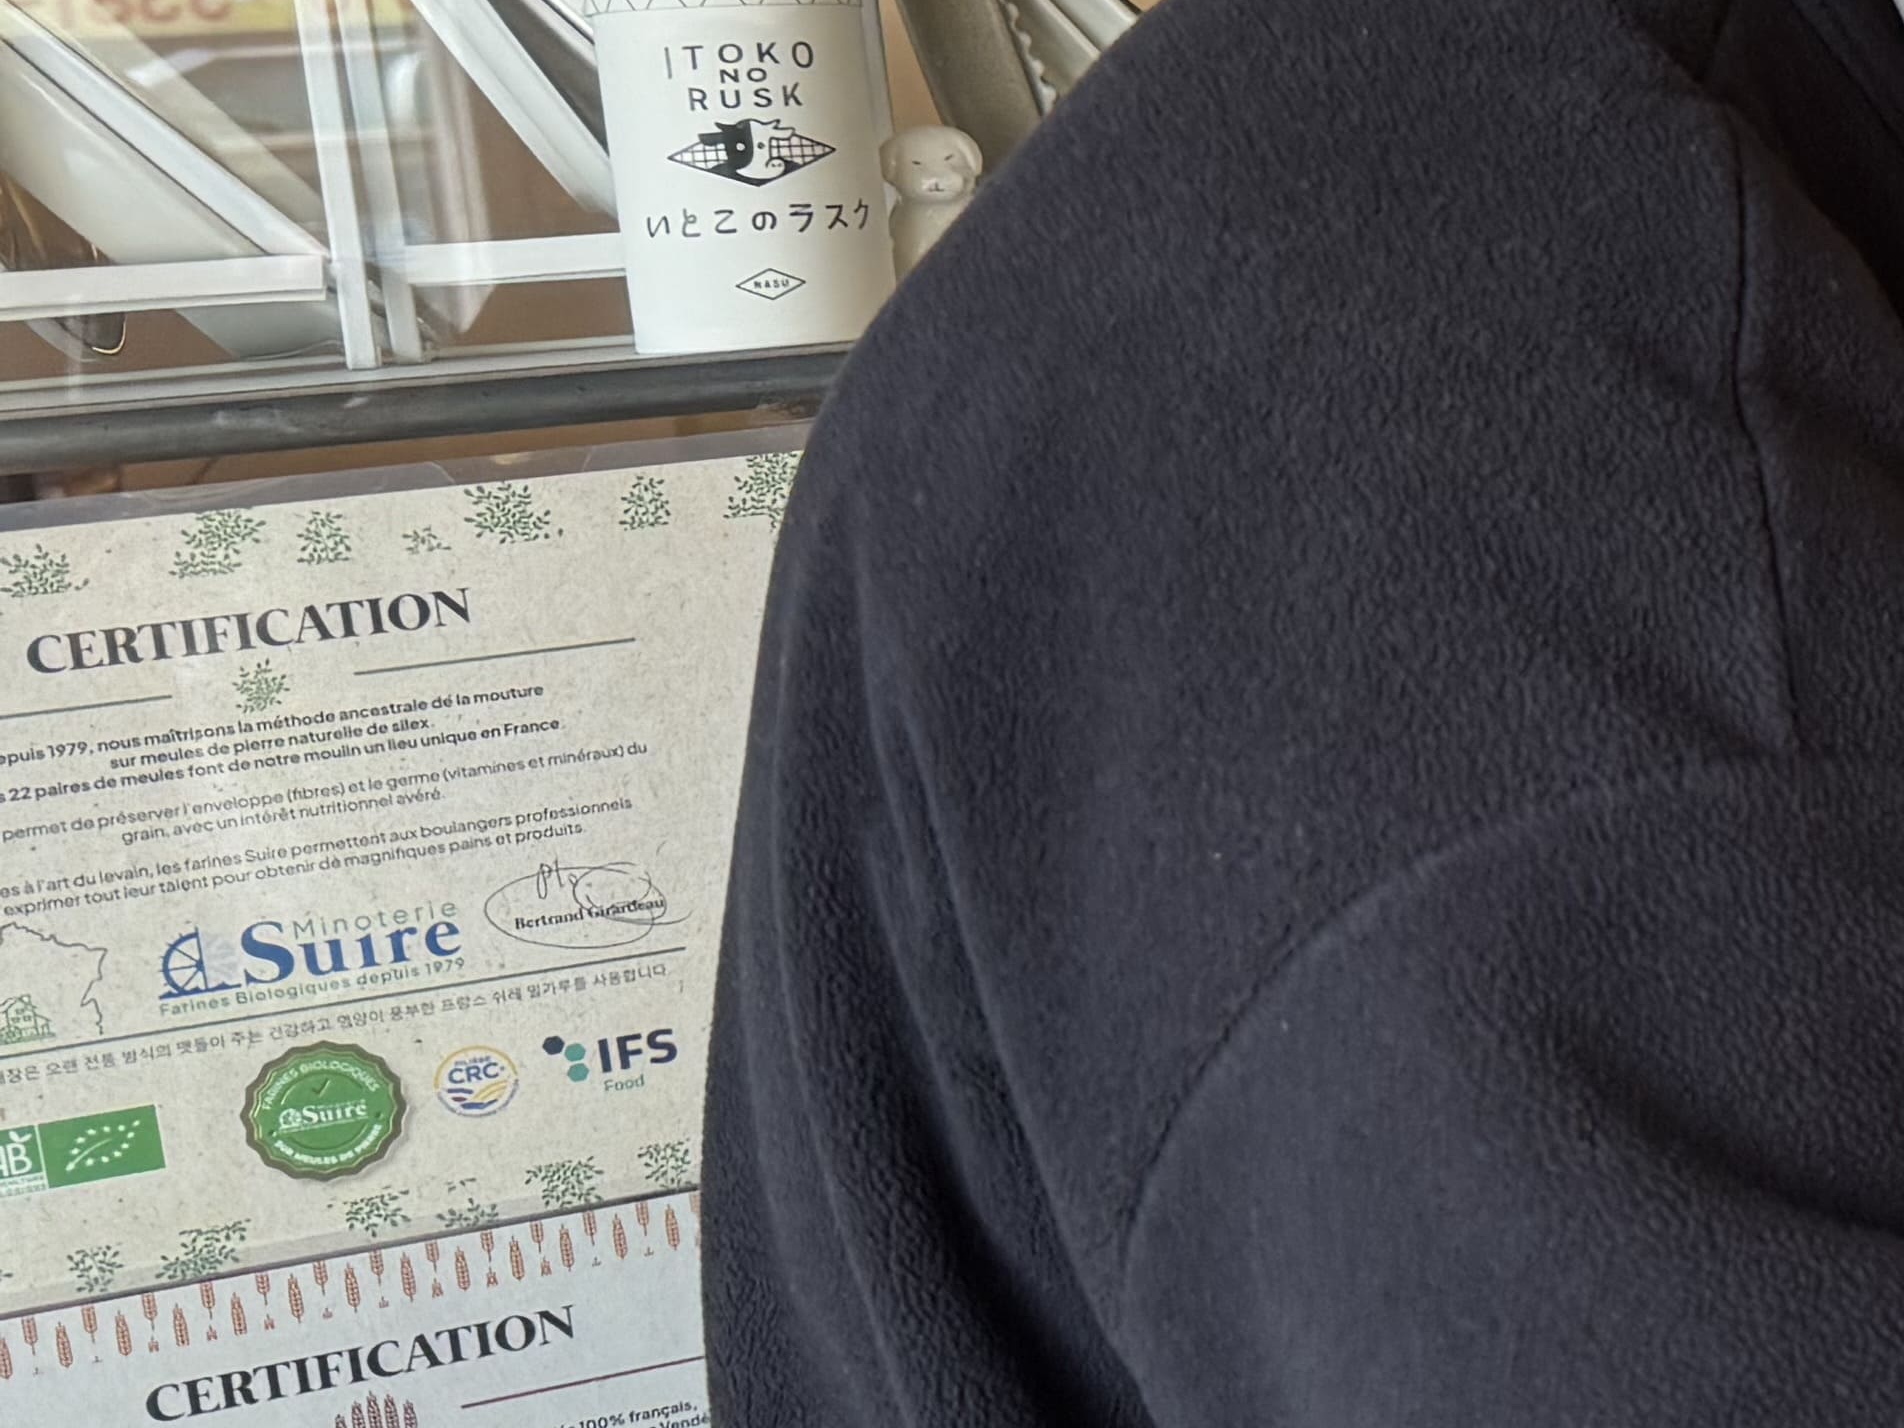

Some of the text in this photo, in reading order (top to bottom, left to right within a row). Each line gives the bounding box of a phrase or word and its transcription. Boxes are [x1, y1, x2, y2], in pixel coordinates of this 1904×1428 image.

[664, 41, 814, 79] ITOKO
[720, 67, 768, 84] NO
[688, 82, 803, 111] RUSK
[646, 198, 870, 238] いとこのラスク
[26, 579, 470, 681] CERTIFICATION
[48, 738, 93, 760] 1979,
[97, 735, 140, 752] nous
[237, 718, 252, 733] la
[256, 709, 335, 733] méthode
[340, 696, 427, 722] ancestrale
[456, 691, 471, 707] la
[474, 682, 543, 705] mouture
[293, 897, 456, 940] Minoterie
[514, 908, 583, 931] Bertrand
[240, 915, 461, 986] Suire
[159, 957, 464, 1017] Farines Biologiques depuis 1979
[597, 1026, 677, 1074] IFS
[448, 1060, 497, 1086] CRC
[604, 1075, 644, 1094] Food
[145, 1301, 574, 1427] CERTIFICATION
[628, 1397, 697, 1426] français,
